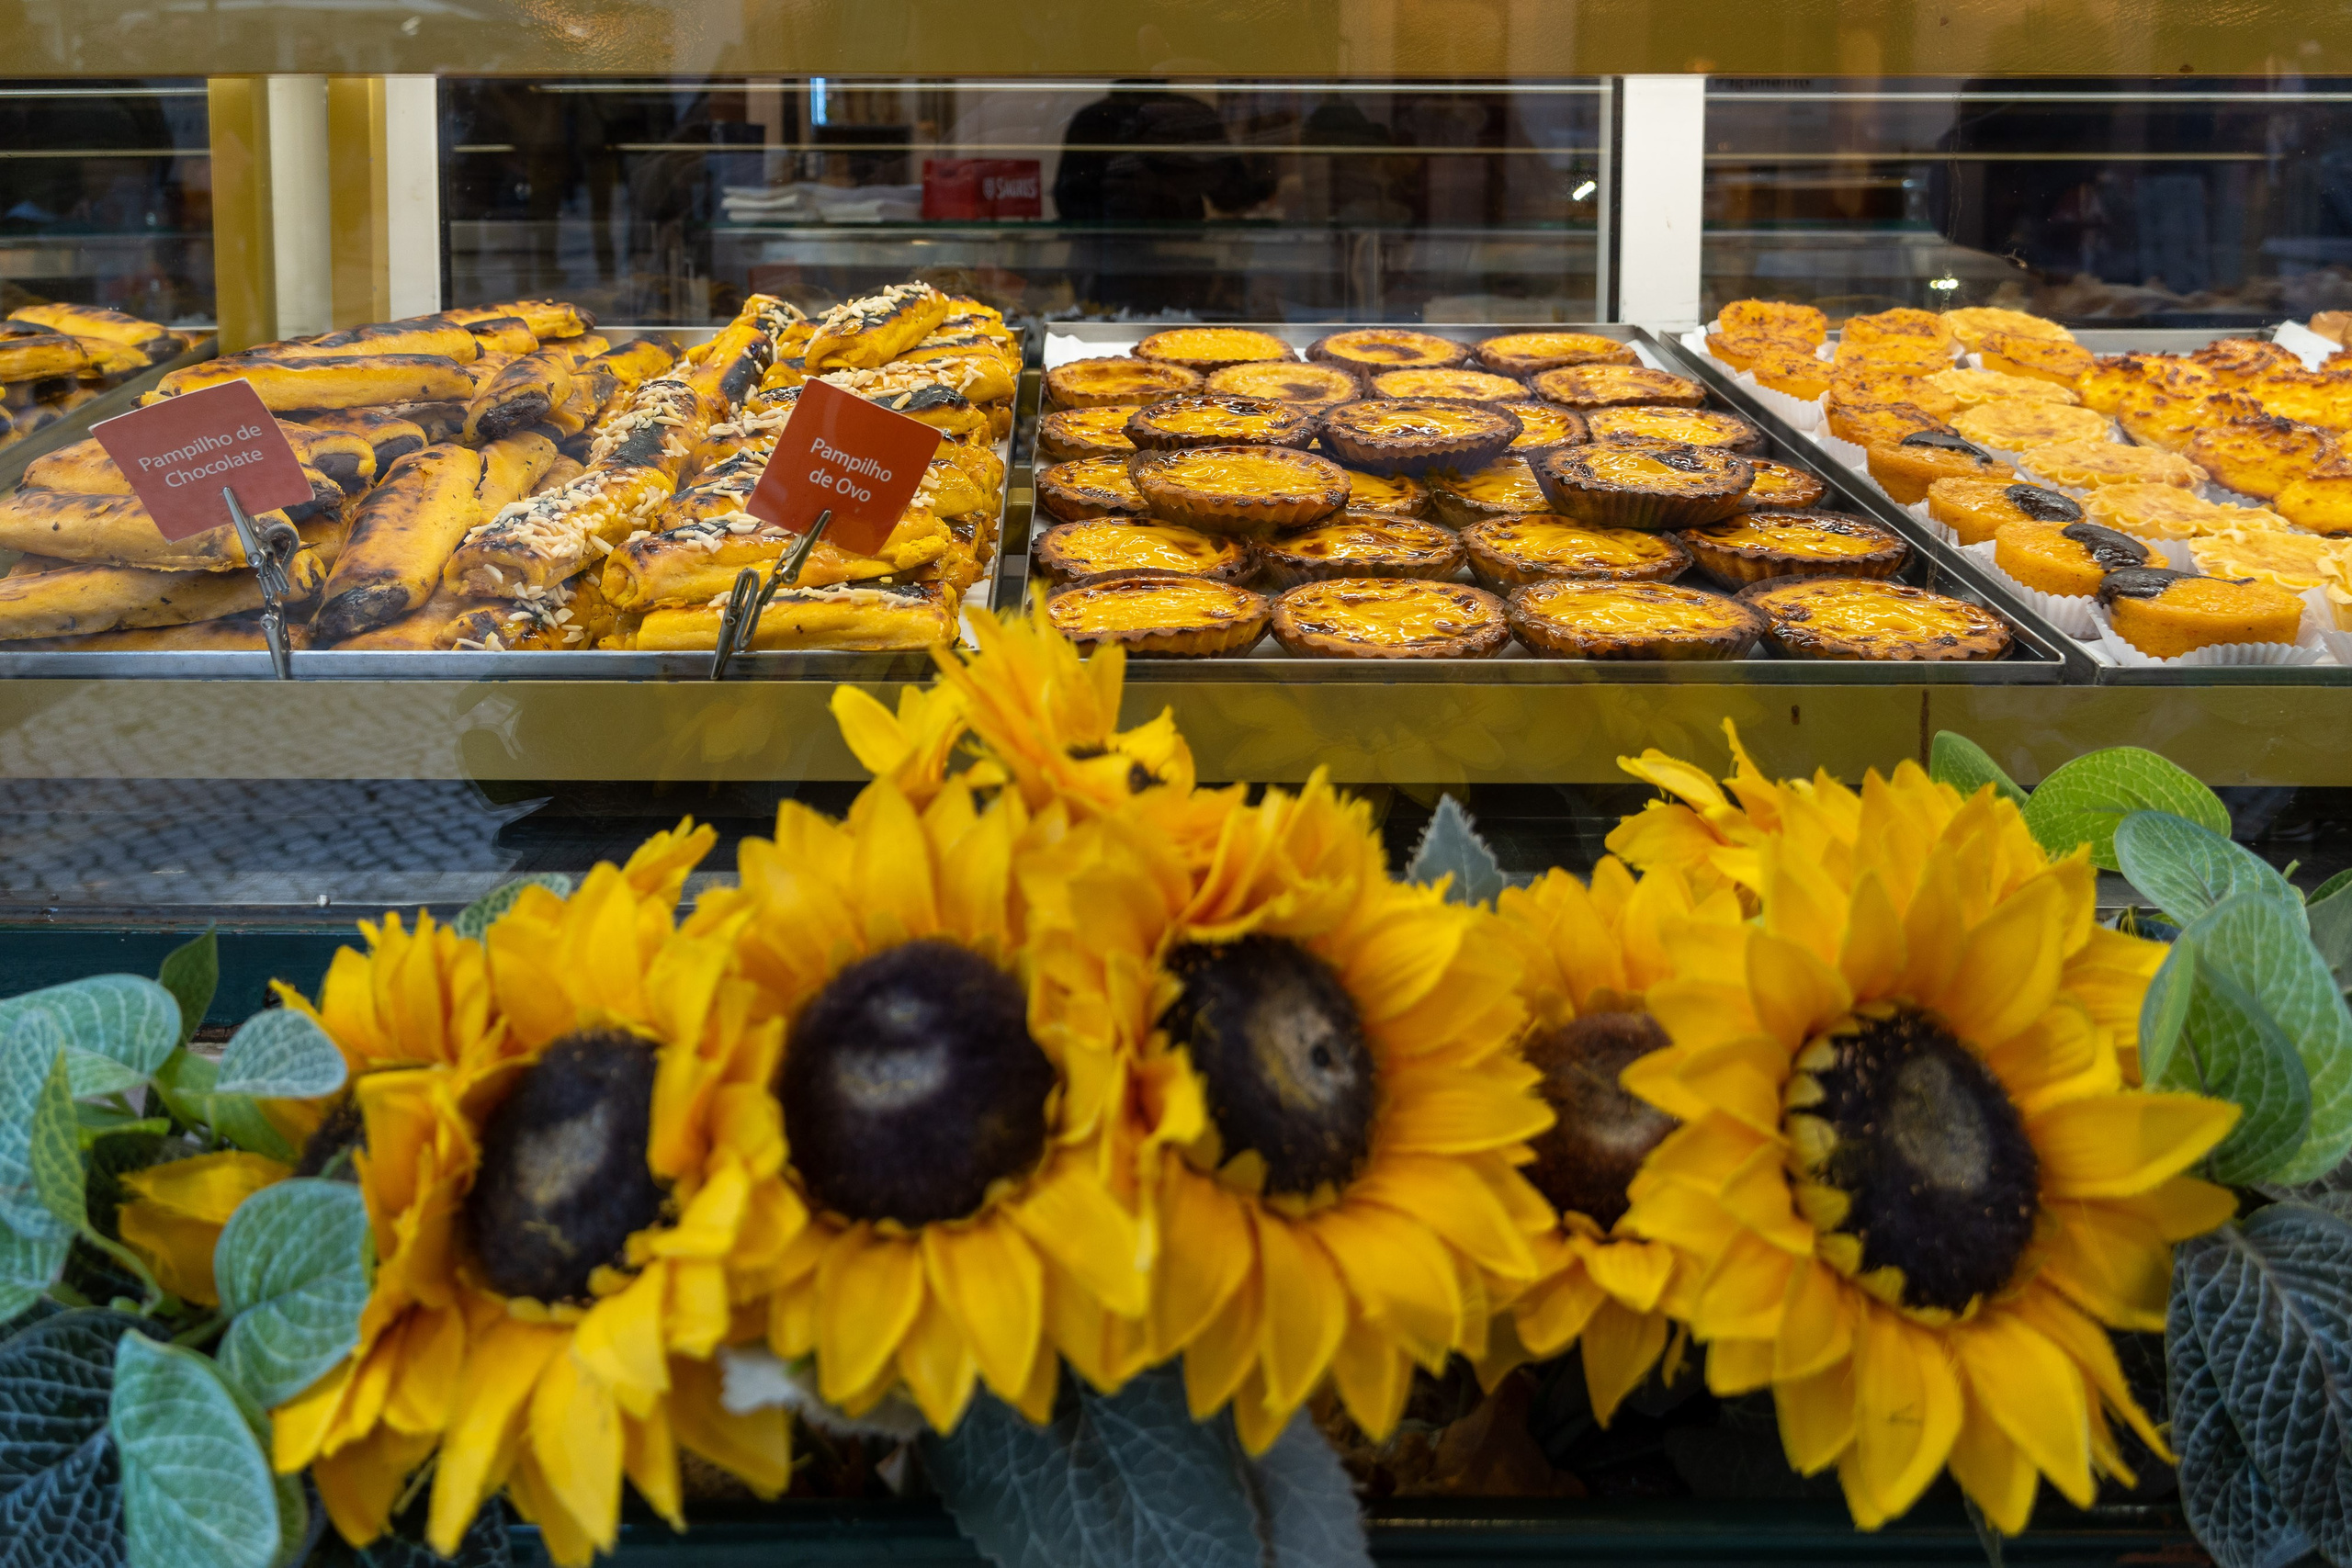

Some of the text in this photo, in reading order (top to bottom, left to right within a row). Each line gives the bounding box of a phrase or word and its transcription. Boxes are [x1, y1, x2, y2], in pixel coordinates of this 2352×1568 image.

[139, 424, 263, 472] Pampilho de
[164, 448, 265, 488] Chocolate
[809, 437, 893, 482] Pampilho
[808, 468, 872, 502] de Ovo
